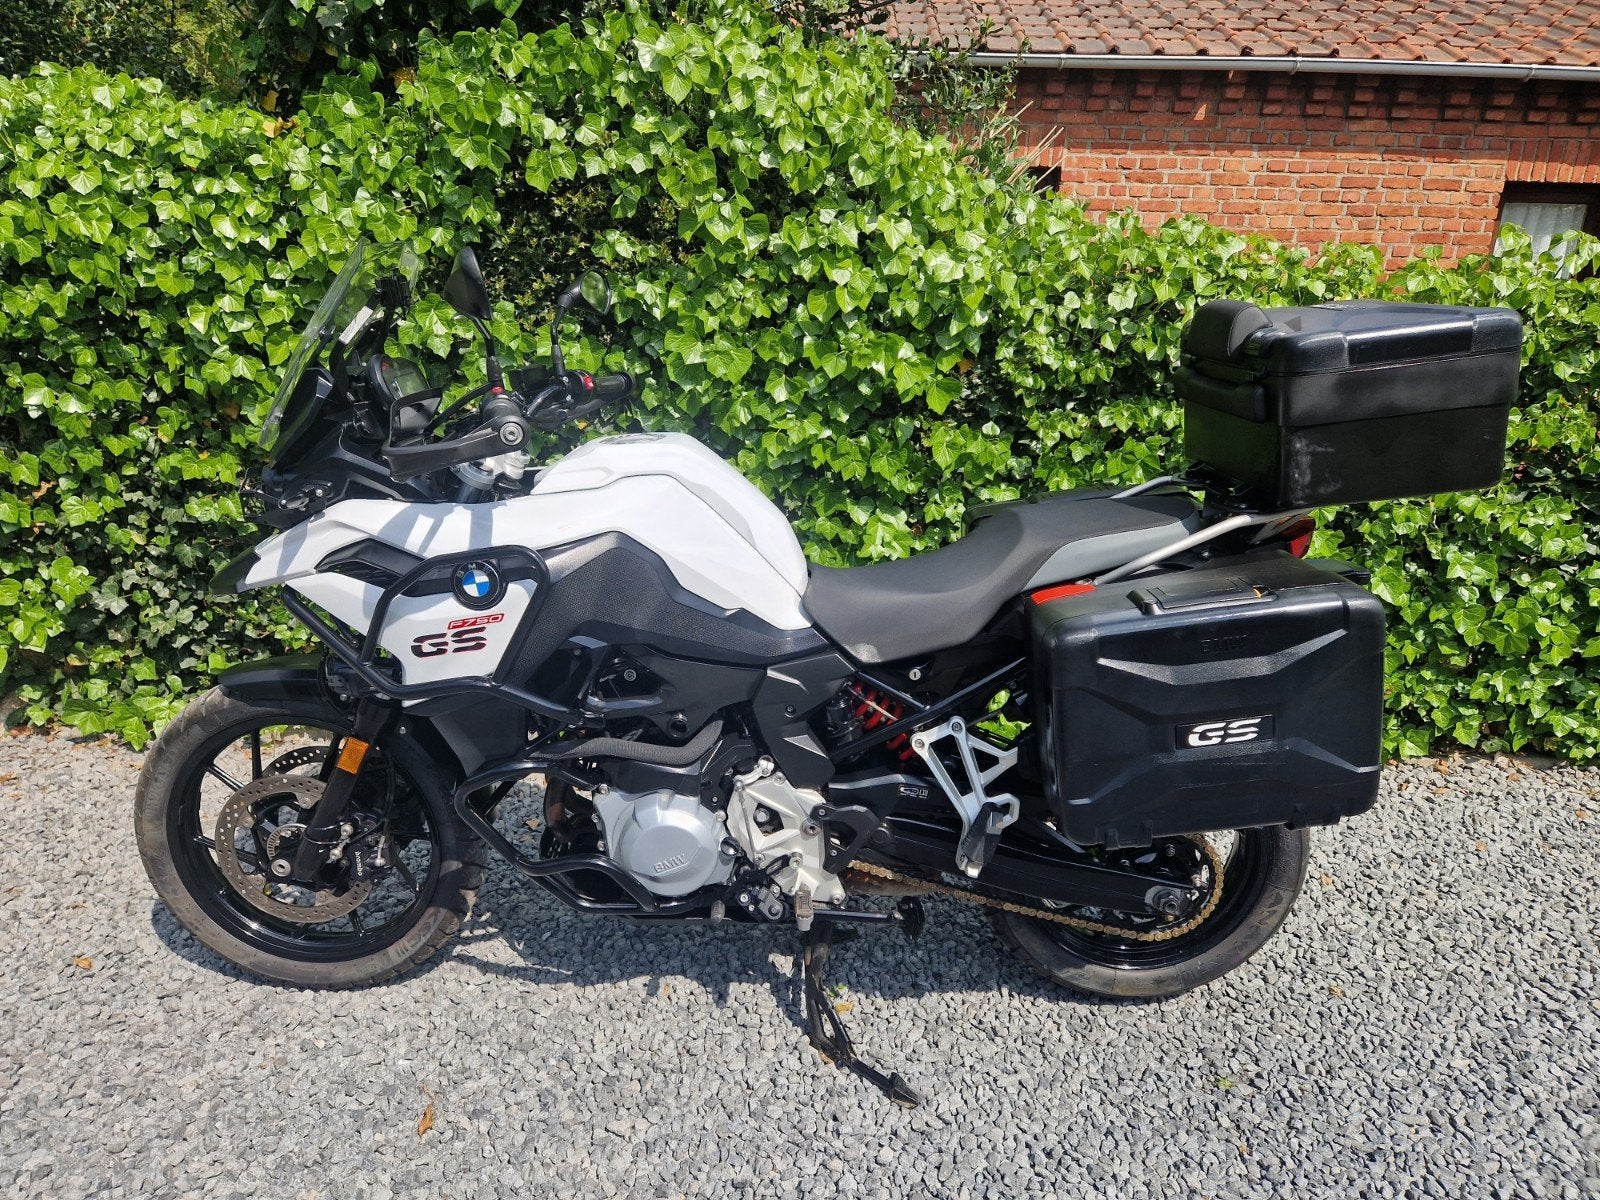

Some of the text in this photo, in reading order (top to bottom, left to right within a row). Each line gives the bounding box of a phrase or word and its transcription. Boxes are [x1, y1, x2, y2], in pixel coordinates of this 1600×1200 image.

[448, 613, 504, 630] F750
[410, 627, 488, 659] GS
[1188, 718, 1262, 747] GS
[354, 851, 363, 877] brembo
[653, 853, 686, 874] BMW
